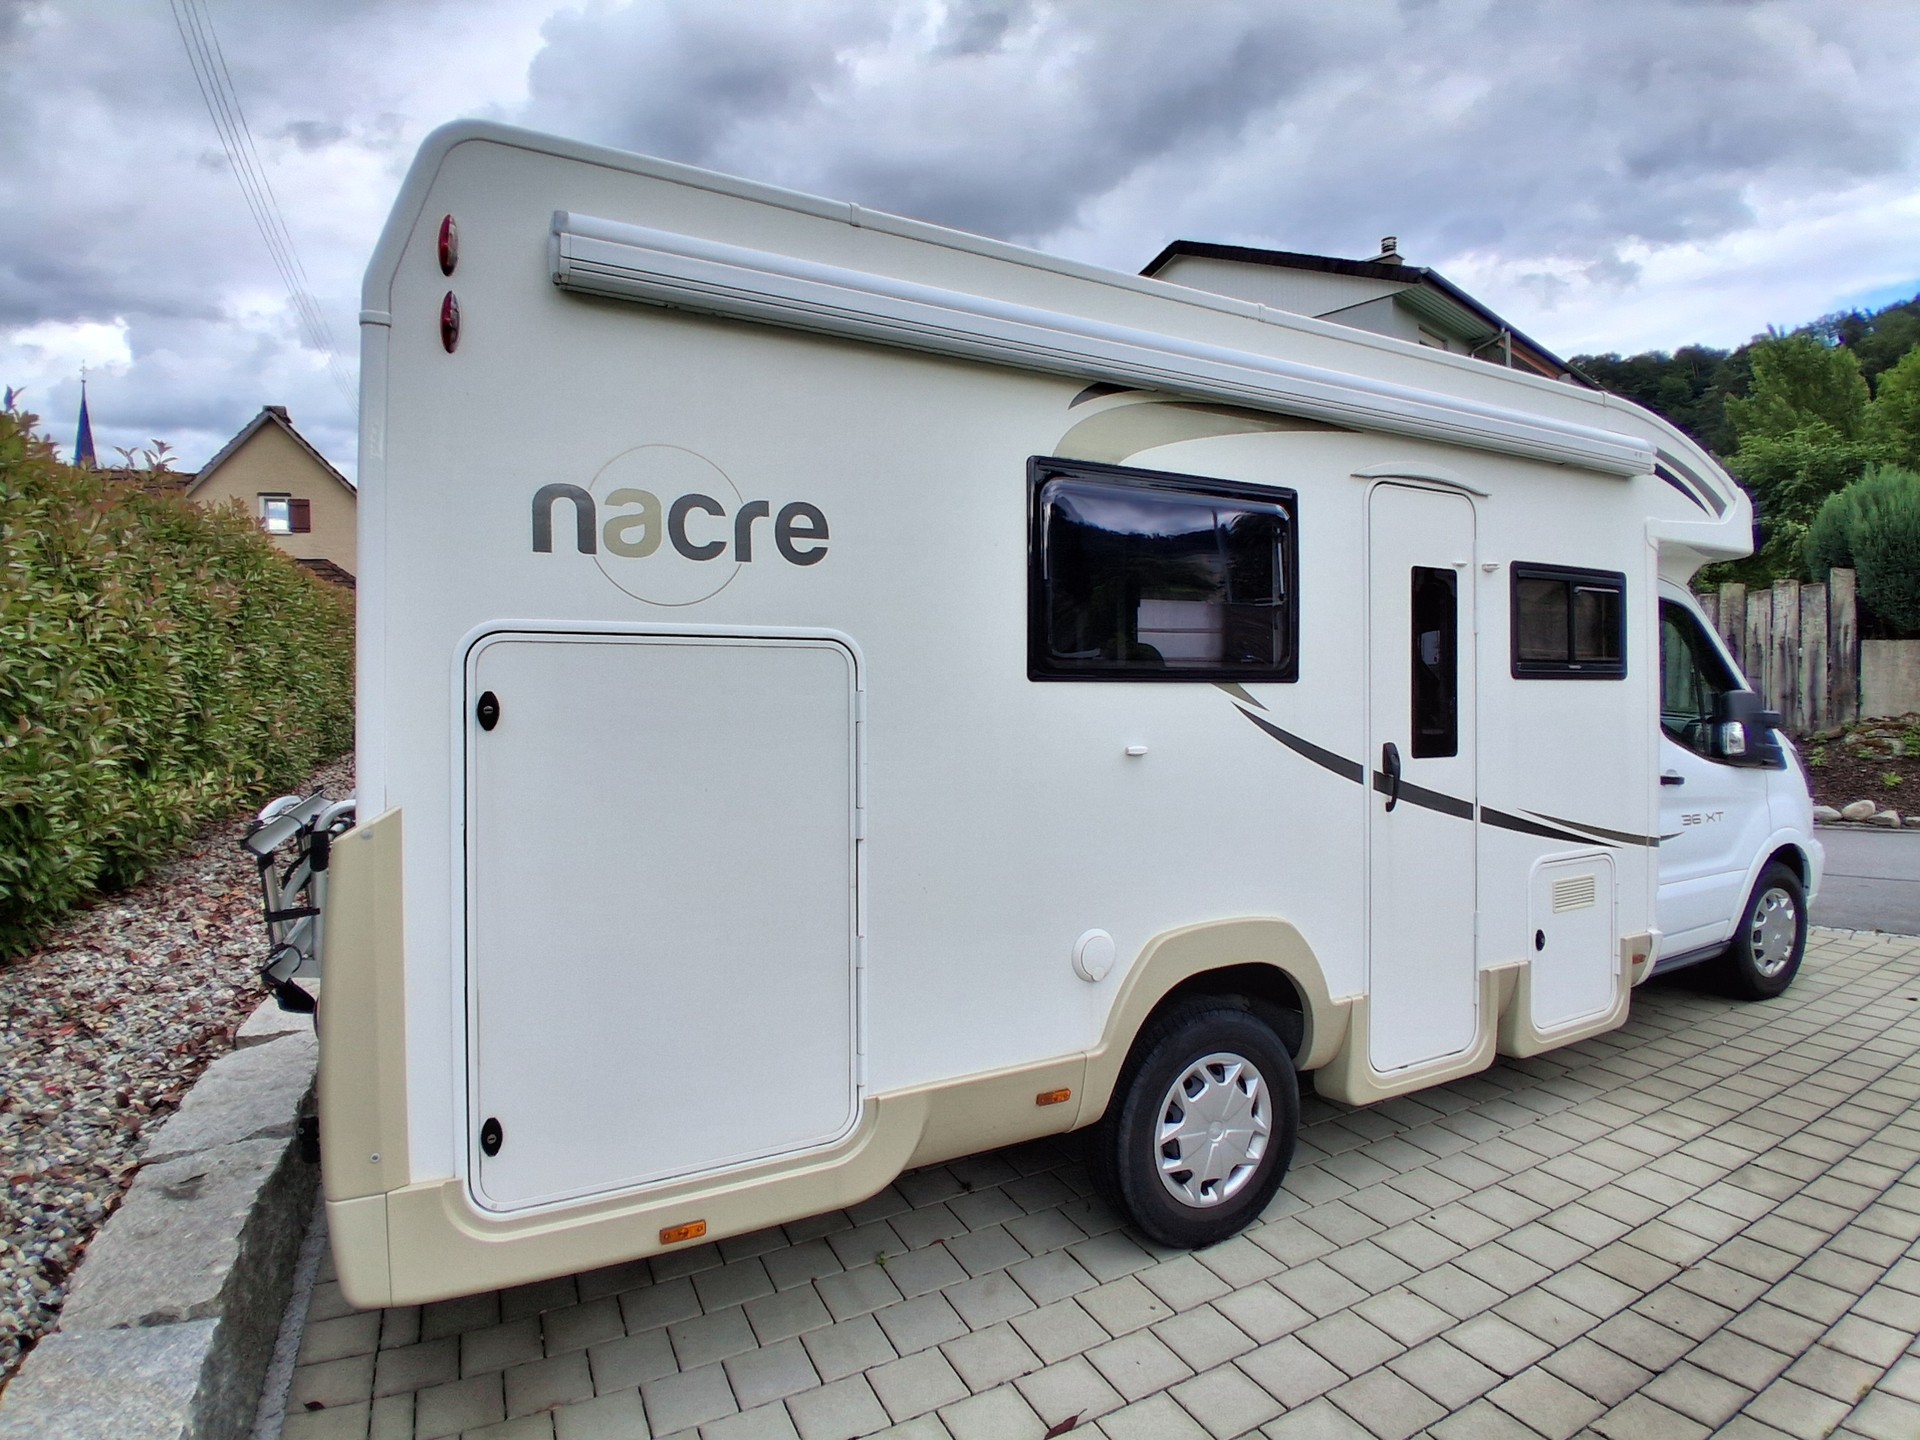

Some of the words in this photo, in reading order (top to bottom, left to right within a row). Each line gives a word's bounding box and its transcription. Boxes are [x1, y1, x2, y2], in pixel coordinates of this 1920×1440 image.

[532, 483, 829, 566] nacre
[1681, 813, 1701, 826] 36
[1705, 811, 1724, 822] XT
